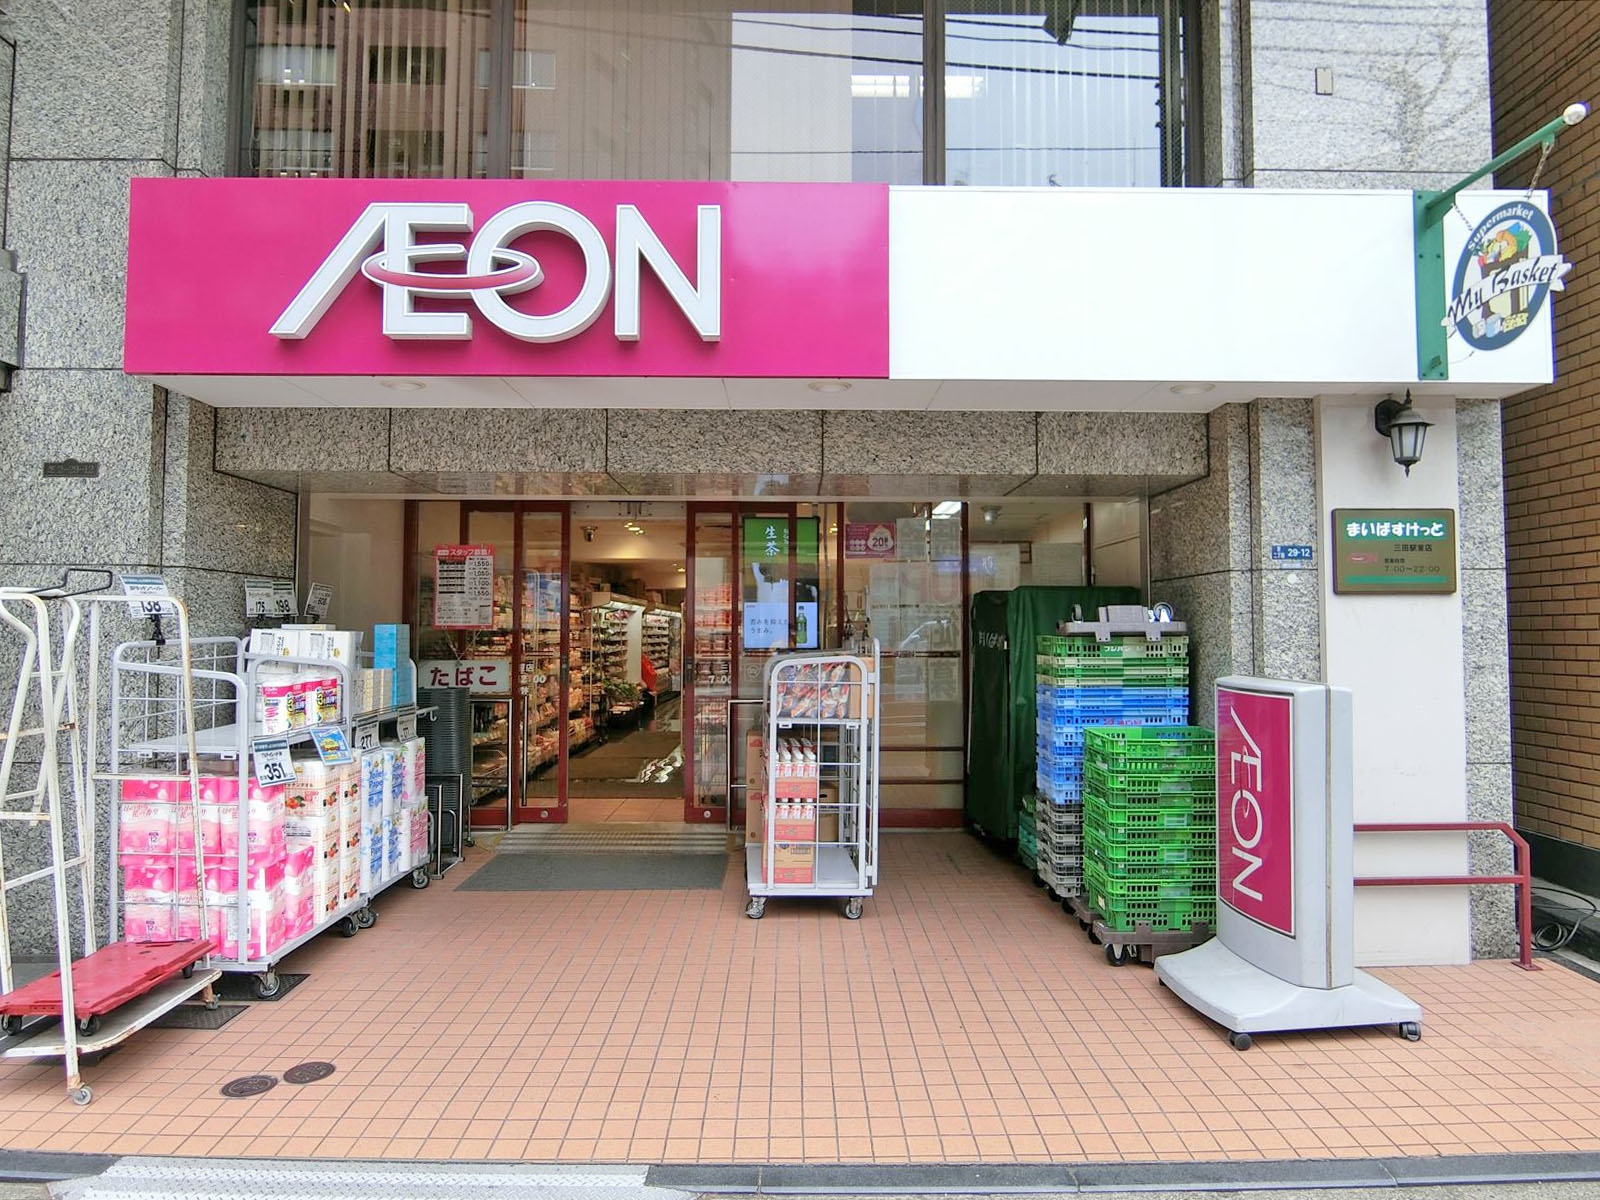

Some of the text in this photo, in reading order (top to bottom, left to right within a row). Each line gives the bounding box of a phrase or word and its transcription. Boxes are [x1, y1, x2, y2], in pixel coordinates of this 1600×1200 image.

[1468, 204, 1534, 250] supermarket
[1448, 257, 1557, 323] My Basket
[1346, 522, 1444, 536] まいばすけっと
[765, 526, 780, 556] 生茶
[1287, 548, 1310, 557] 29-12
[430, 666, 497, 686] たばこ
[264, 762, 286, 780] 351
